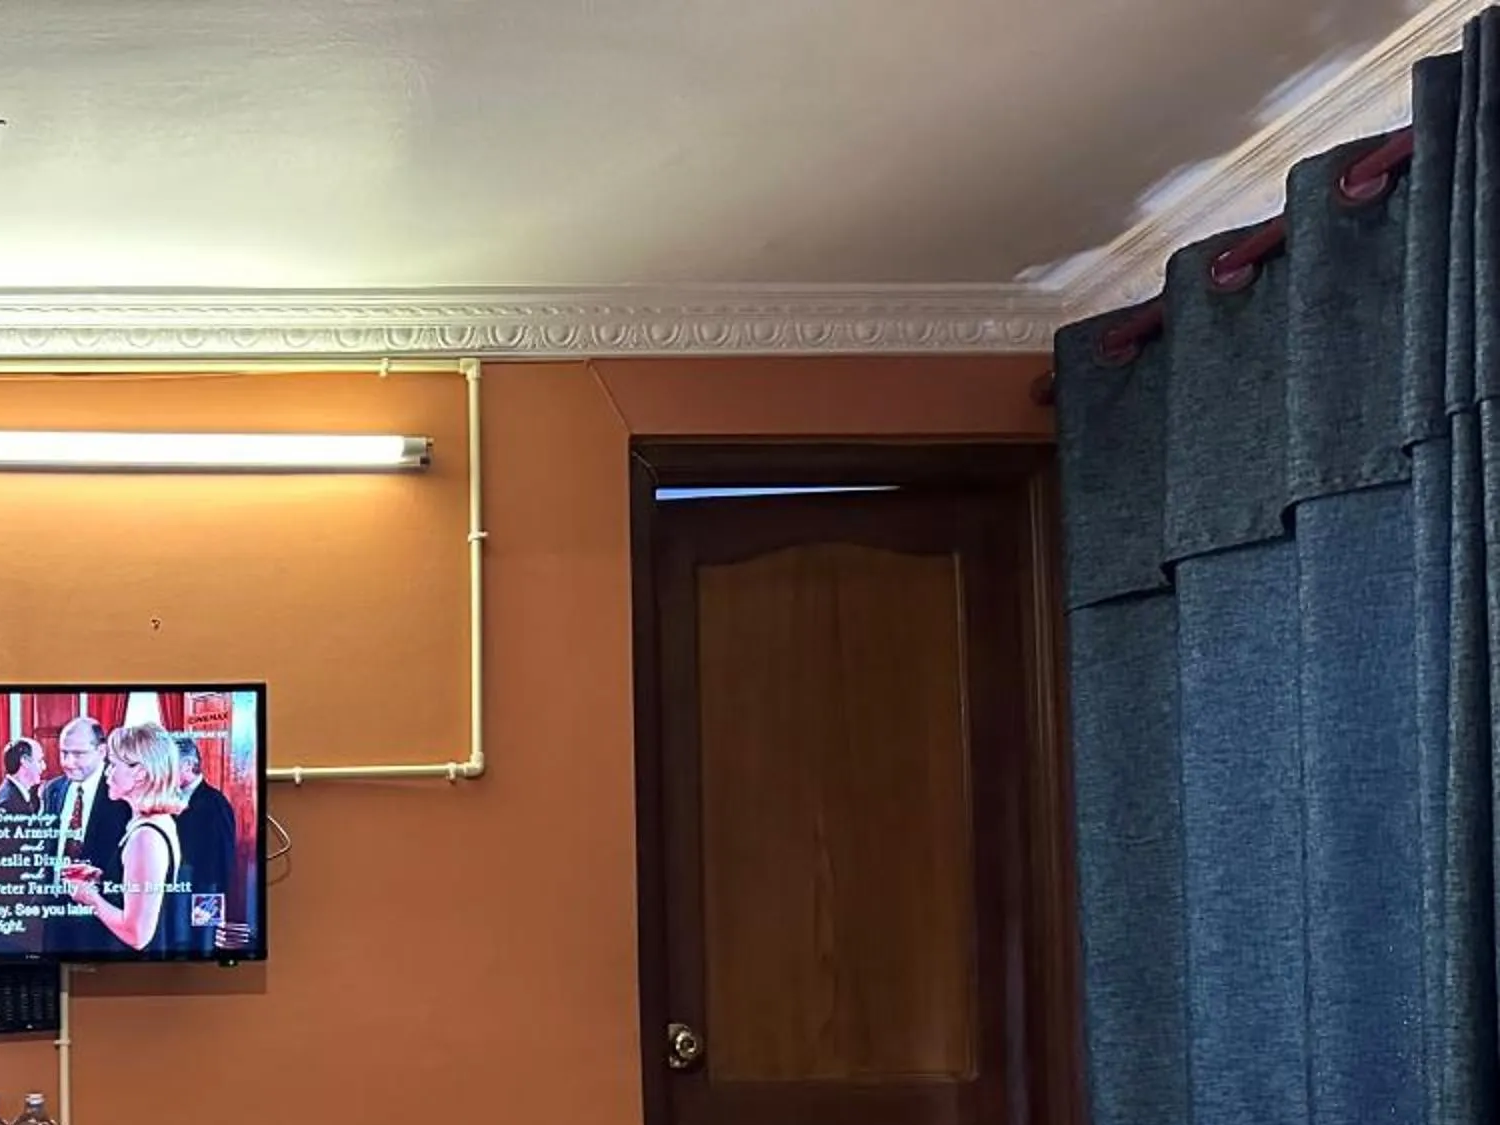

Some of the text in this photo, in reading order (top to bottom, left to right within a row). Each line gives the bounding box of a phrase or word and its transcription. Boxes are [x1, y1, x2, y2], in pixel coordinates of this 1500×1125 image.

[187, 711, 229, 725] CINEMAX
[15, 903, 41, 916] See
[41, 906, 66, 919] you
